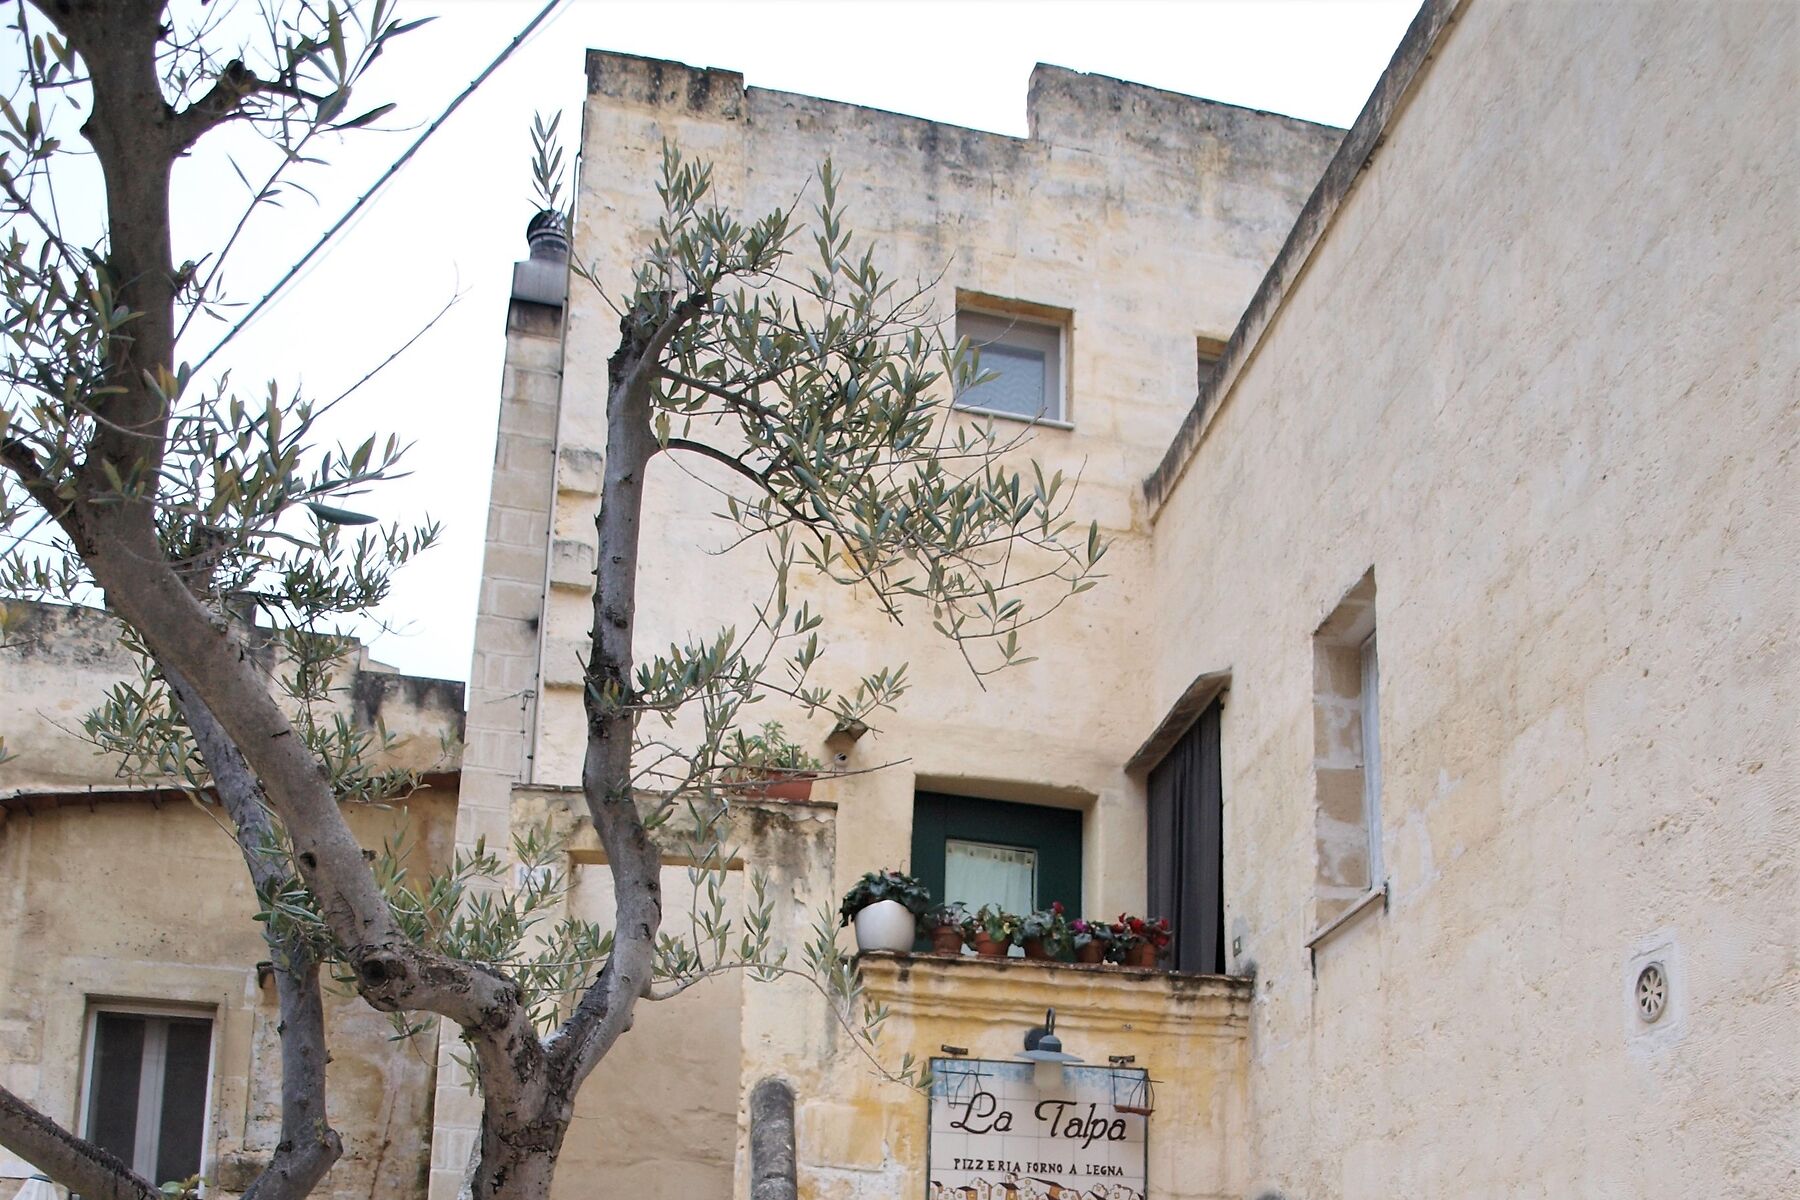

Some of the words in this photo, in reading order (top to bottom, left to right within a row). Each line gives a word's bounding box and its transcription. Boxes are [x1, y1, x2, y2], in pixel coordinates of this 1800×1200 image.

[950, 1092, 1013, 1134] La
[1034, 1100, 1127, 1150] Talpa
[953, 1158, 1022, 1173] PIZZERIA
[1026, 1162, 1063, 1174] FORNO
[1069, 1164, 1078, 1175] A
[1086, 1164, 1124, 1176] LEGNA
